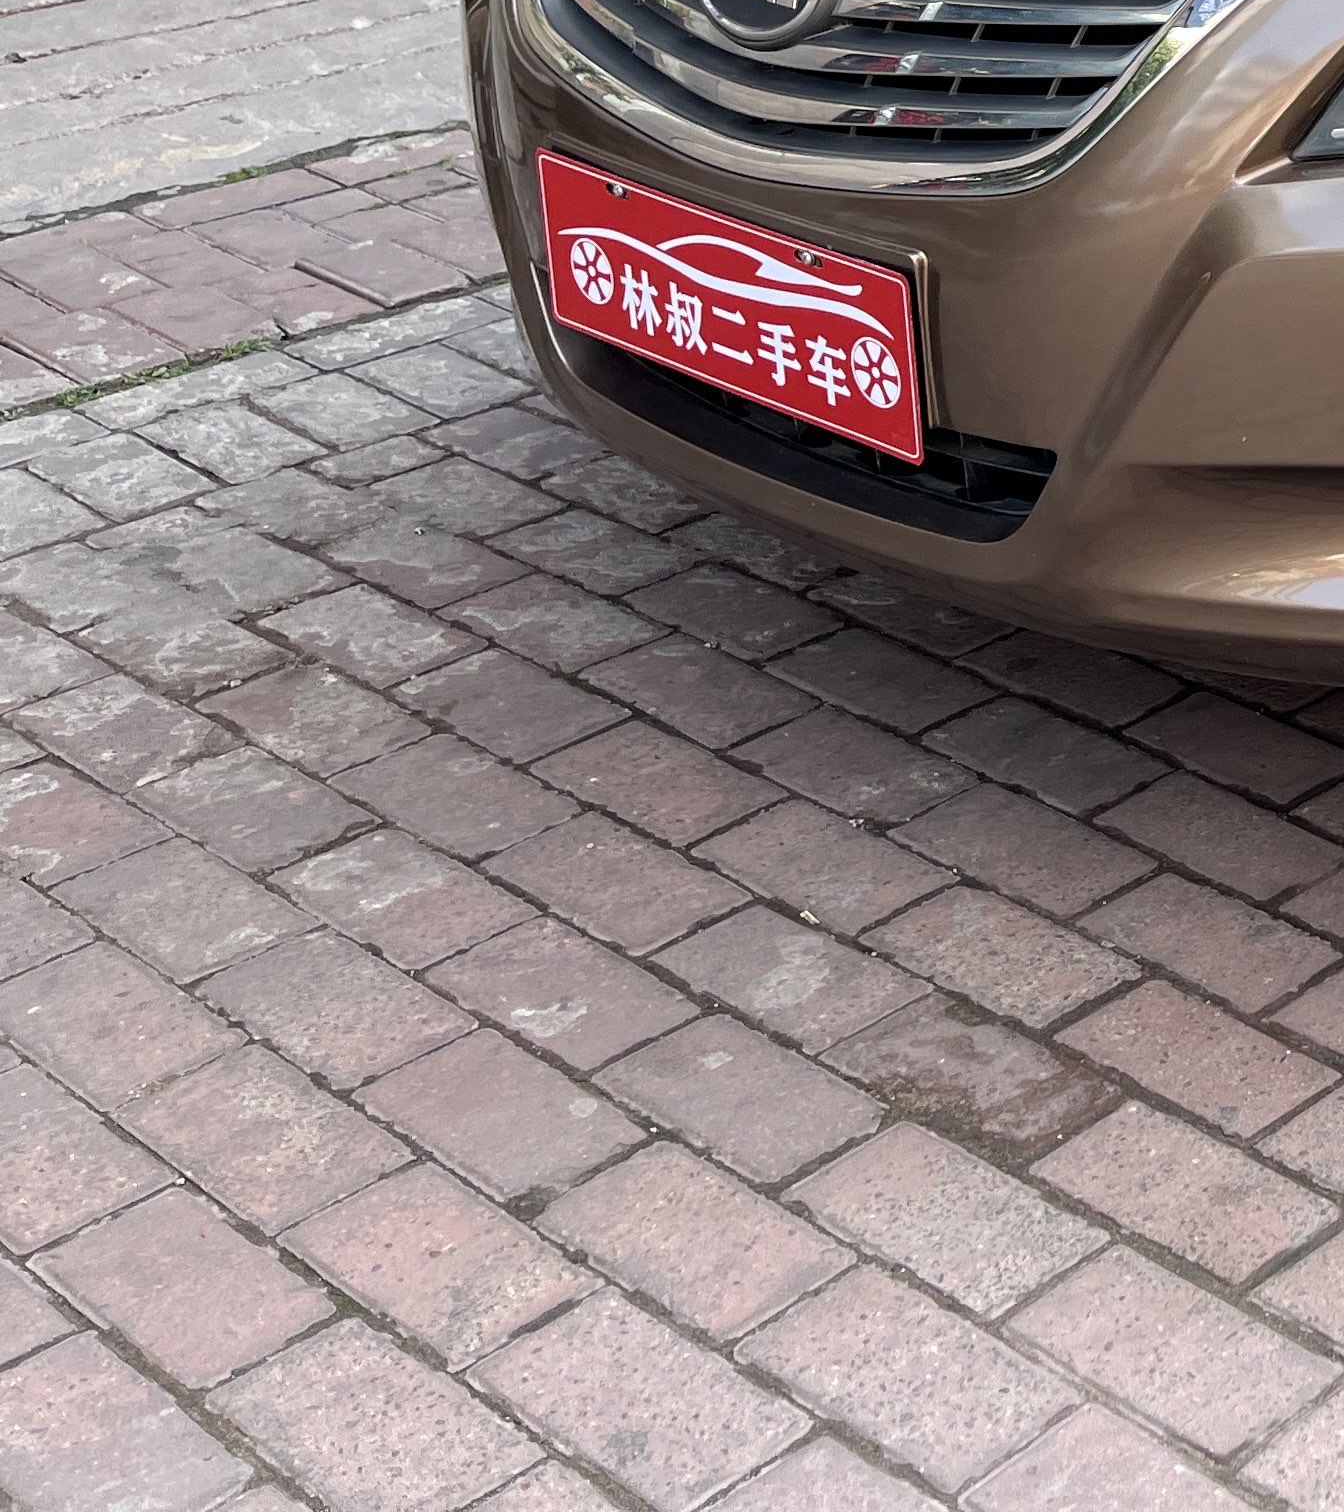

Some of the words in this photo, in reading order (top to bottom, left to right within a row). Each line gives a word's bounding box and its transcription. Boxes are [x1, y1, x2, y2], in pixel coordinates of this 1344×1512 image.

[619, 263, 851, 407] 林叔二手车
